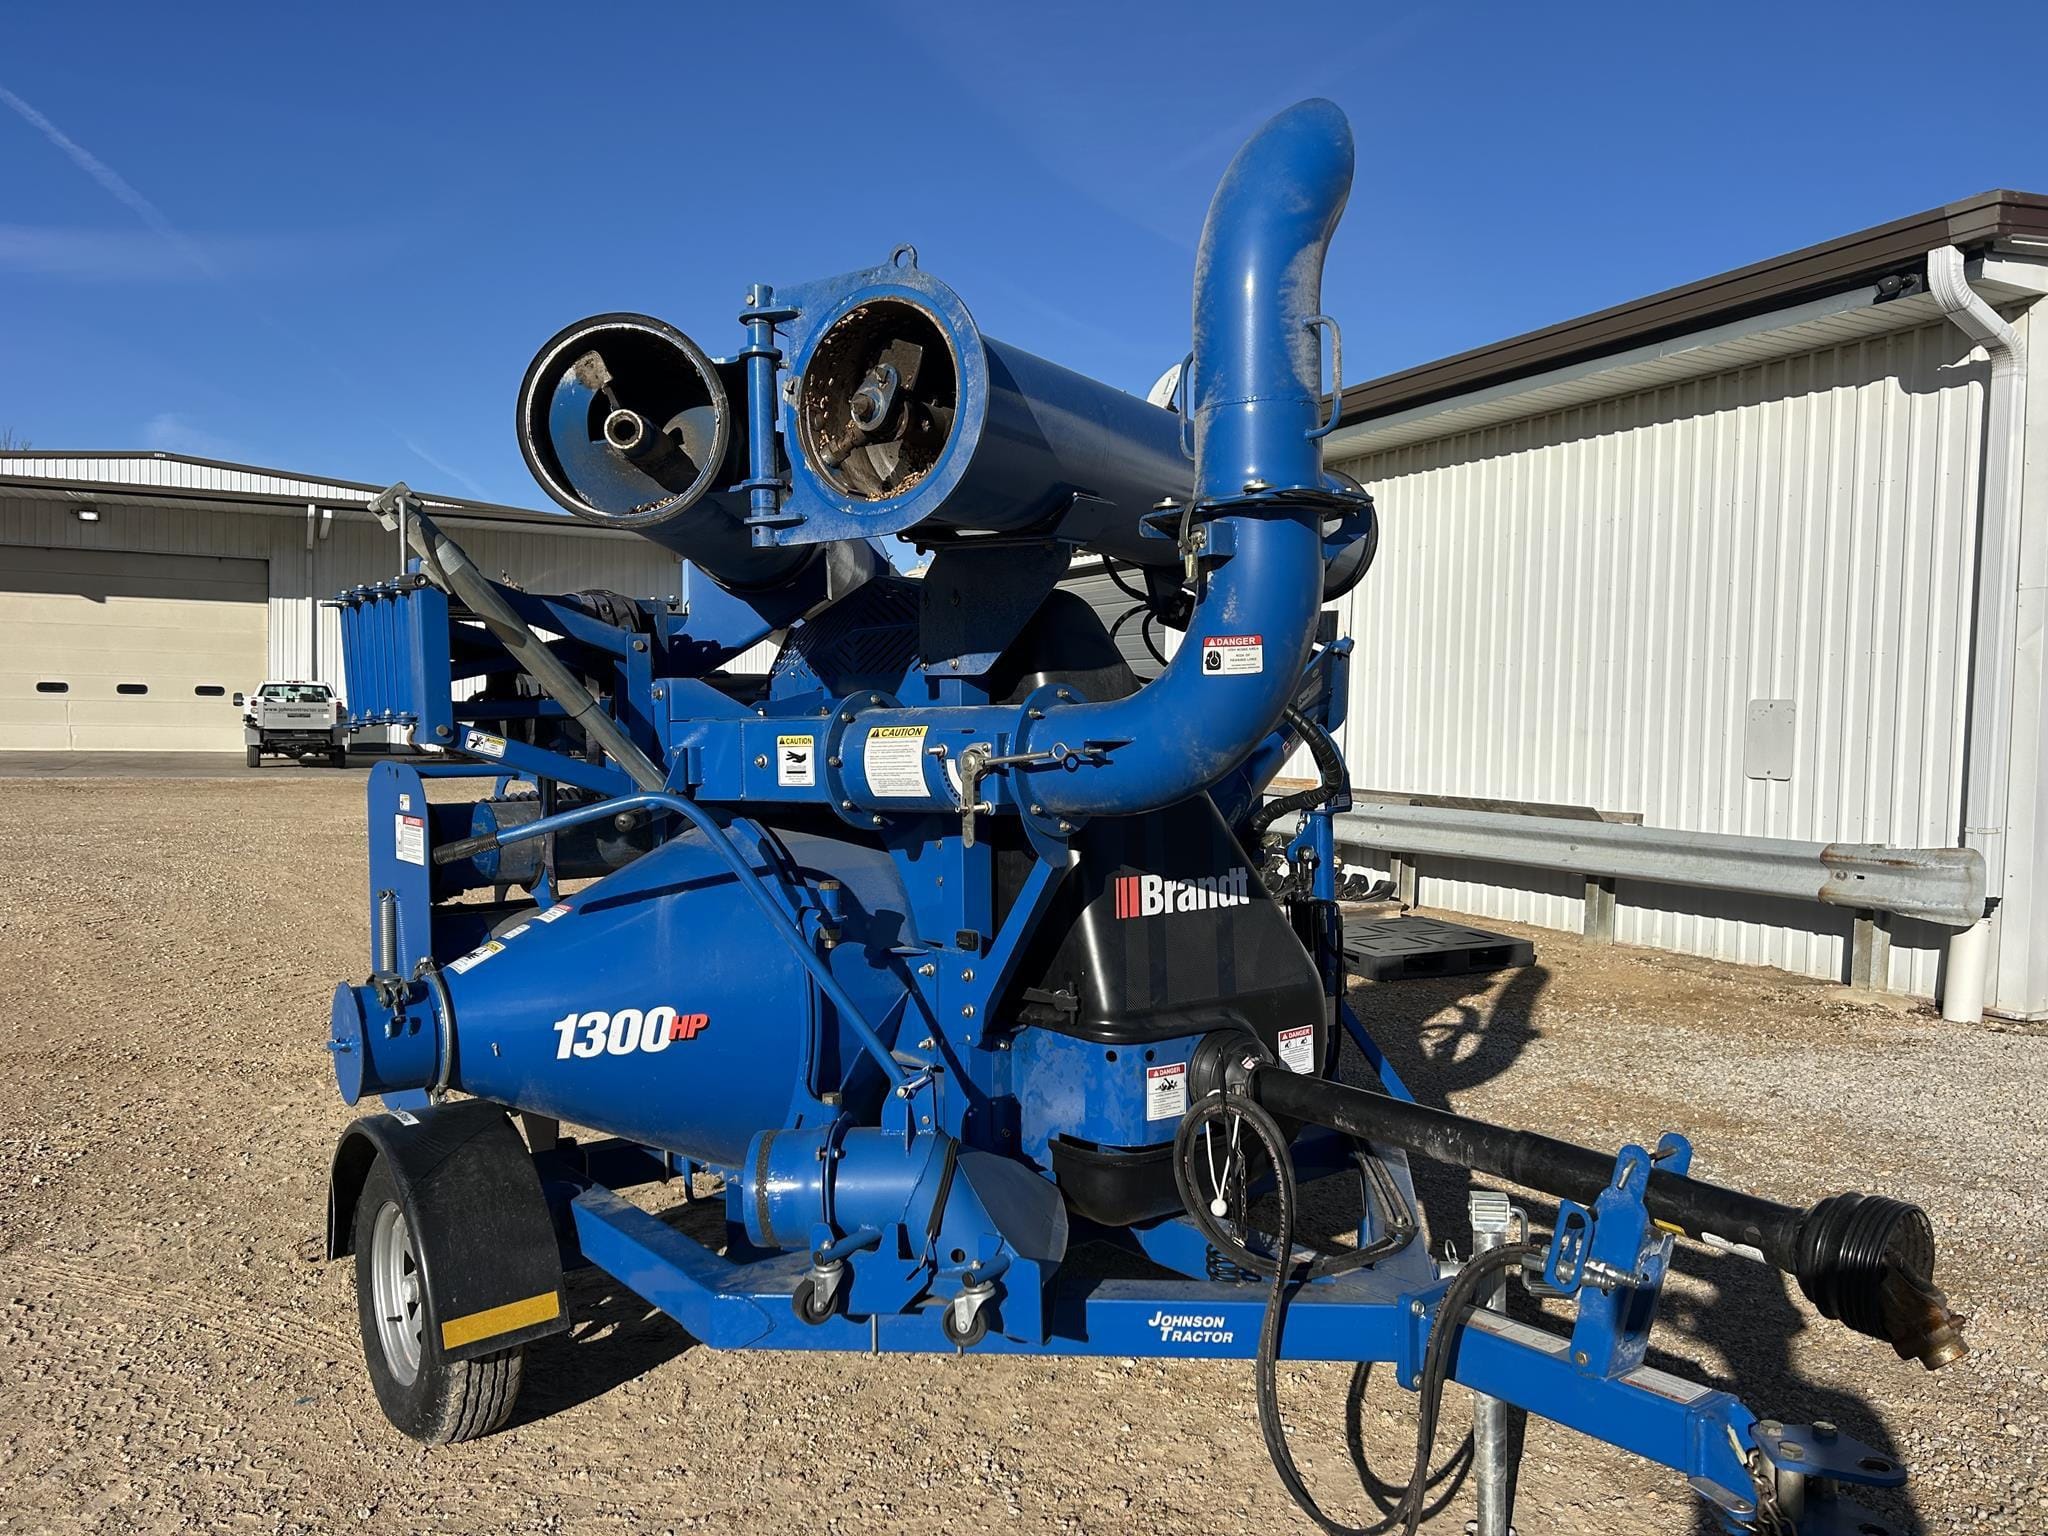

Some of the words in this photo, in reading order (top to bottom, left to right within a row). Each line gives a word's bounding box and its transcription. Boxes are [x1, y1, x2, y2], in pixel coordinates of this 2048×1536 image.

[1216, 637, 1256, 646] DANGER
[881, 727, 923, 737] CAUTION
[785, 737, 812, 745] CAUTION
[1140, 867, 1250, 917] Brandt
[1288, 1028, 1310, 1039] DANGER
[1159, 1066, 1181, 1076] DANGER
[1148, 1311, 1225, 1328] JOHNSON
[1160, 1326, 1234, 1344] TRACTOR
